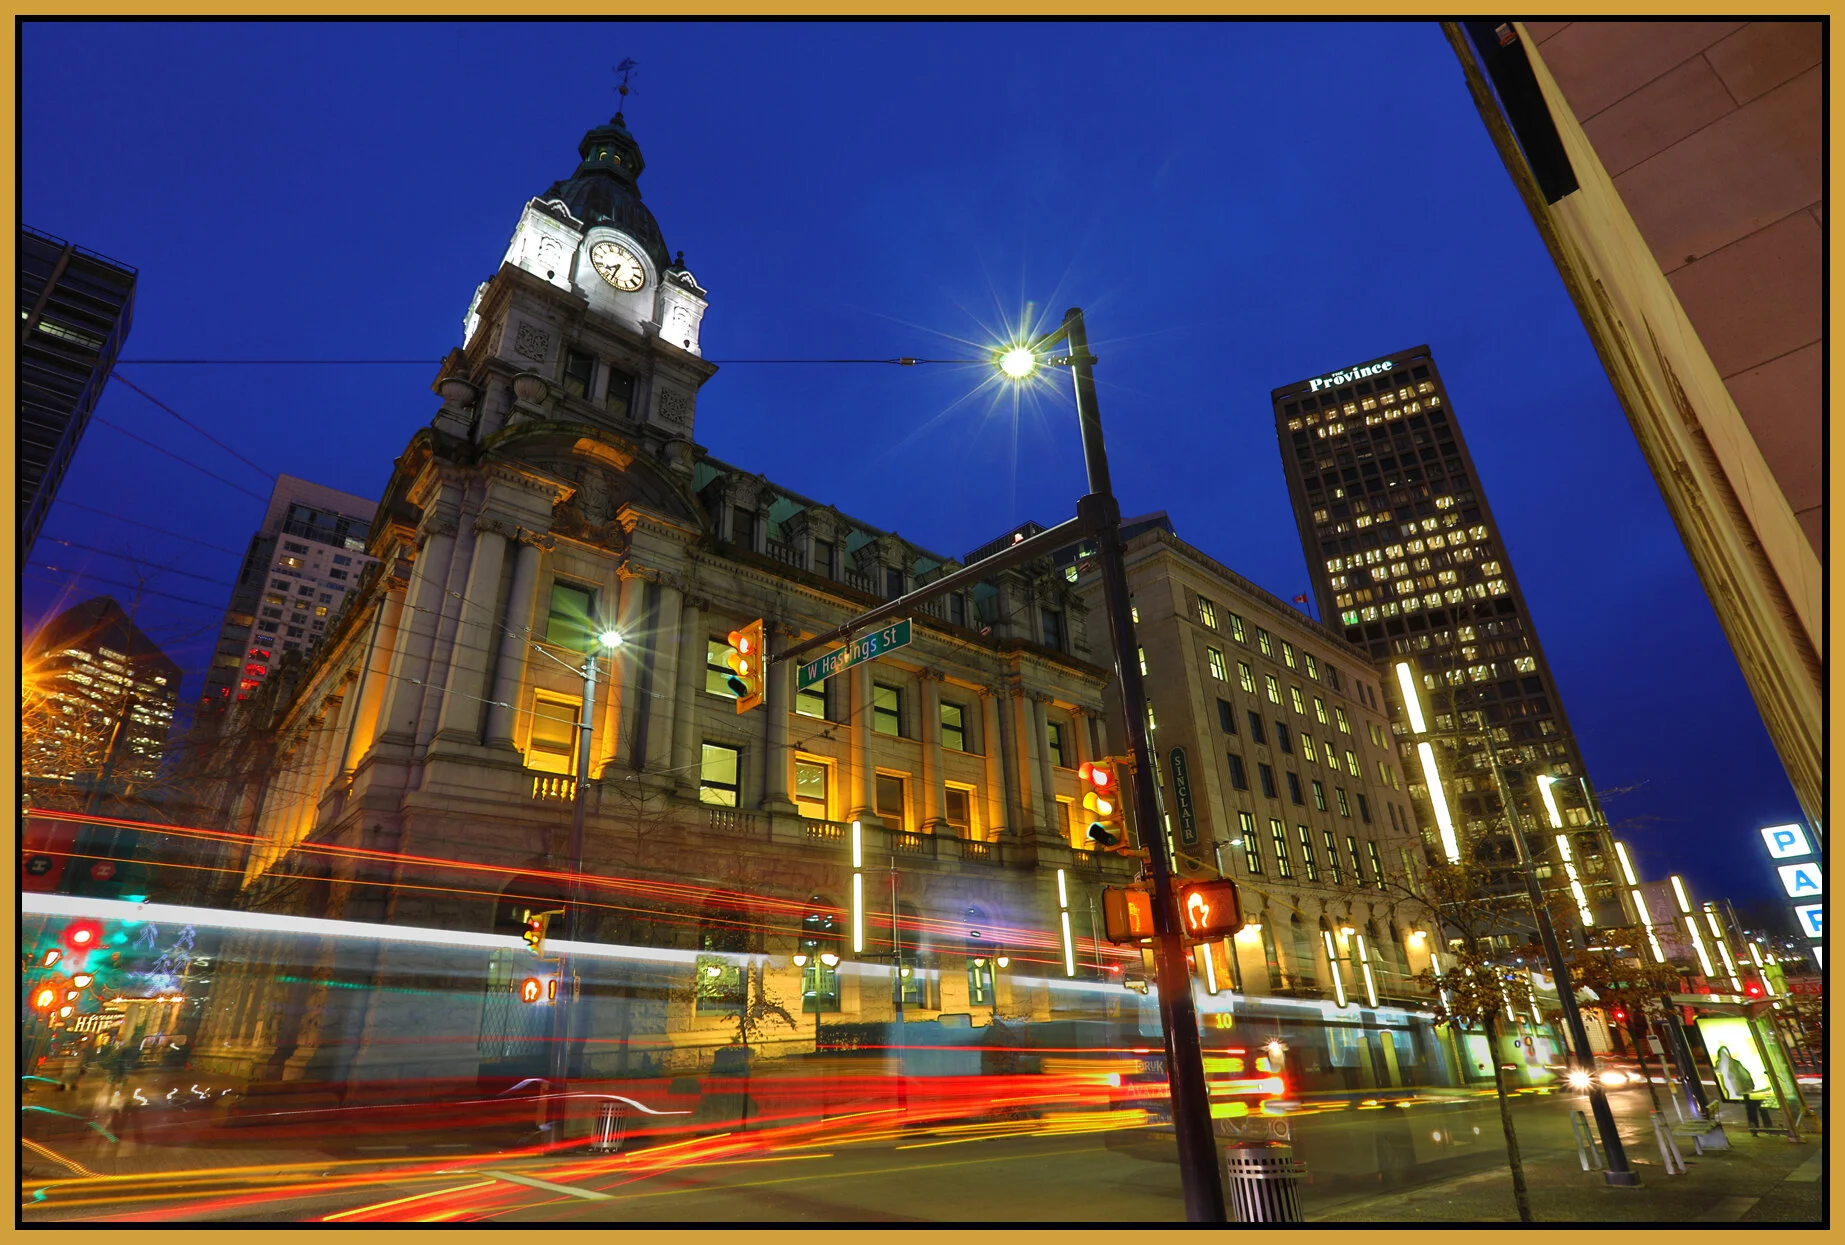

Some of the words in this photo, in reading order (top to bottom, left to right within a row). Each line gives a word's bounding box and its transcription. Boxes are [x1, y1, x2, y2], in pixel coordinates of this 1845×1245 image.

[1309, 361, 1393, 393] Province
[808, 664, 817, 680] W
[883, 627, 896, 647] St
[1174, 756, 1193, 840] SINCLAIR
[1215, 1013, 1232, 1029] 10
